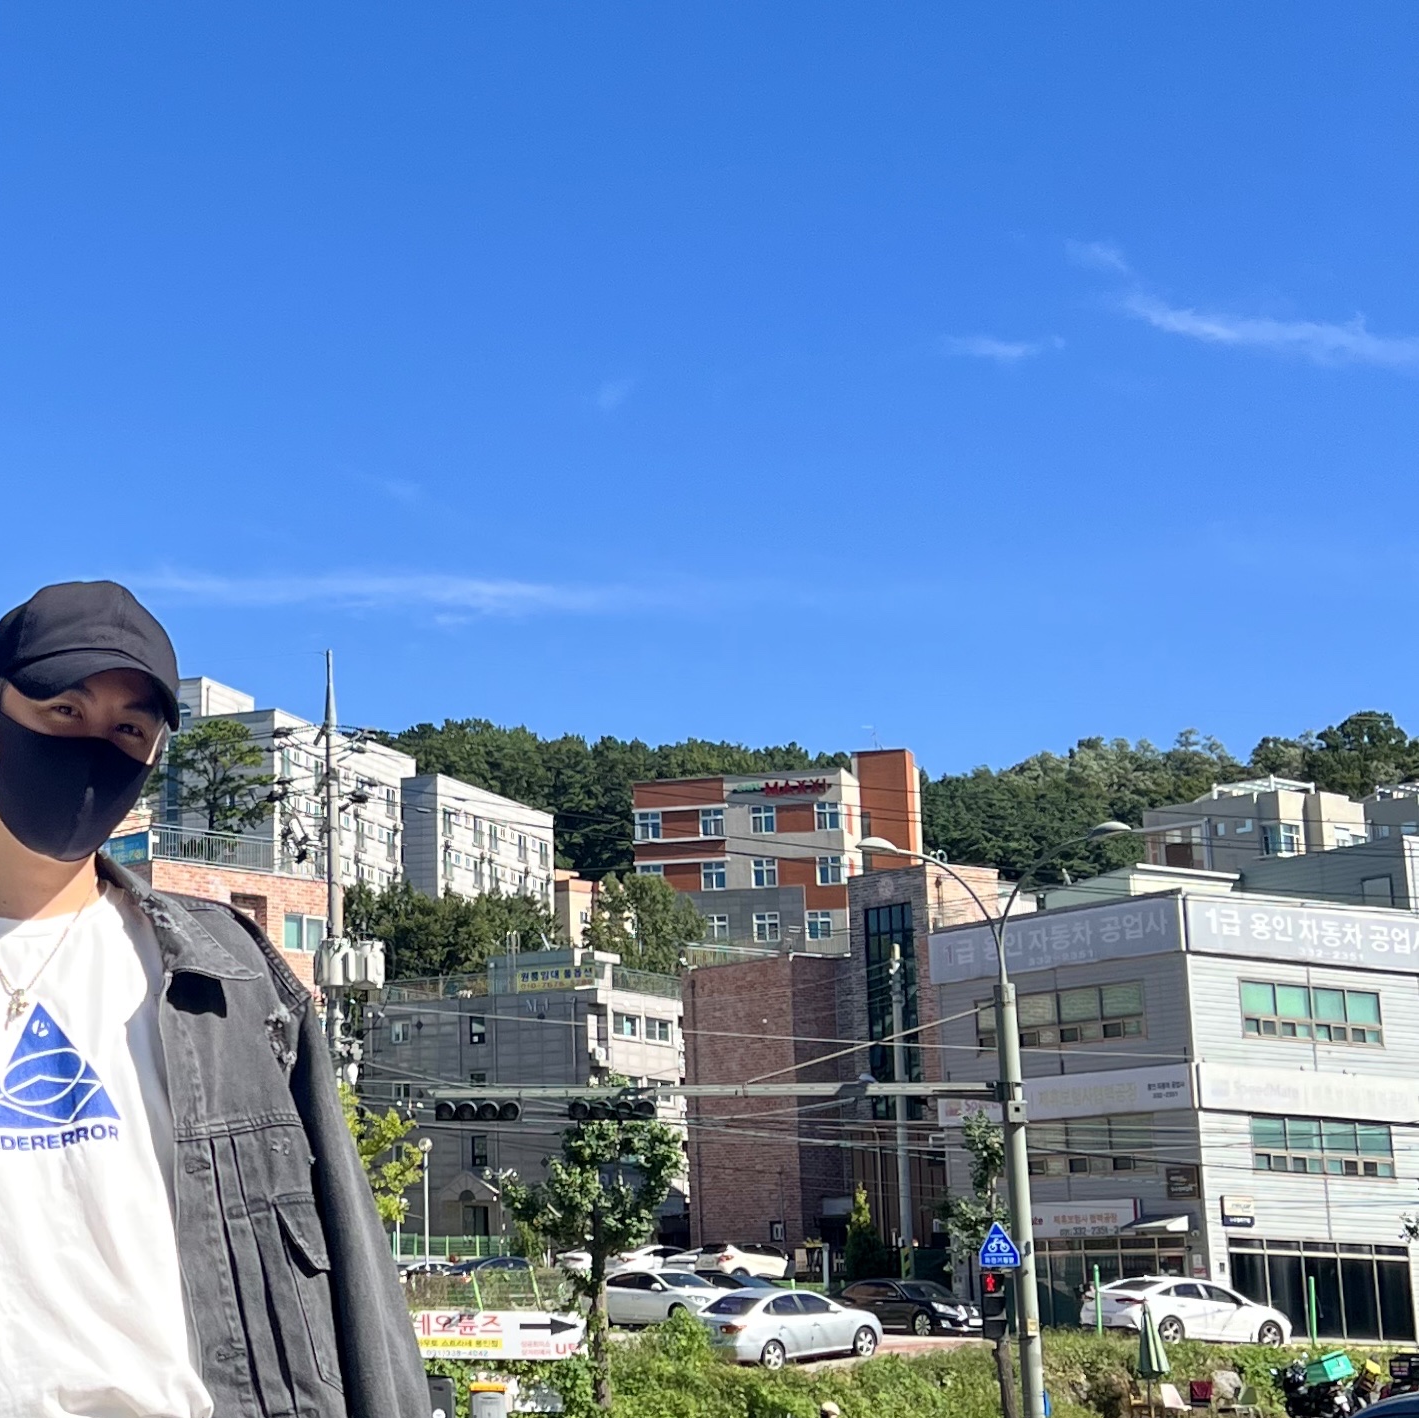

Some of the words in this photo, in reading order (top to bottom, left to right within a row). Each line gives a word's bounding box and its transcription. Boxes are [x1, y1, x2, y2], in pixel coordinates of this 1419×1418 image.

[1028, 922, 1093, 952] 자동차
[1099, 907, 1169, 944] 공업사
[1205, 907, 1241, 937] 1급
[1249, 912, 1294, 943] 용인
[1298, 918, 1363, 950] 자동차
